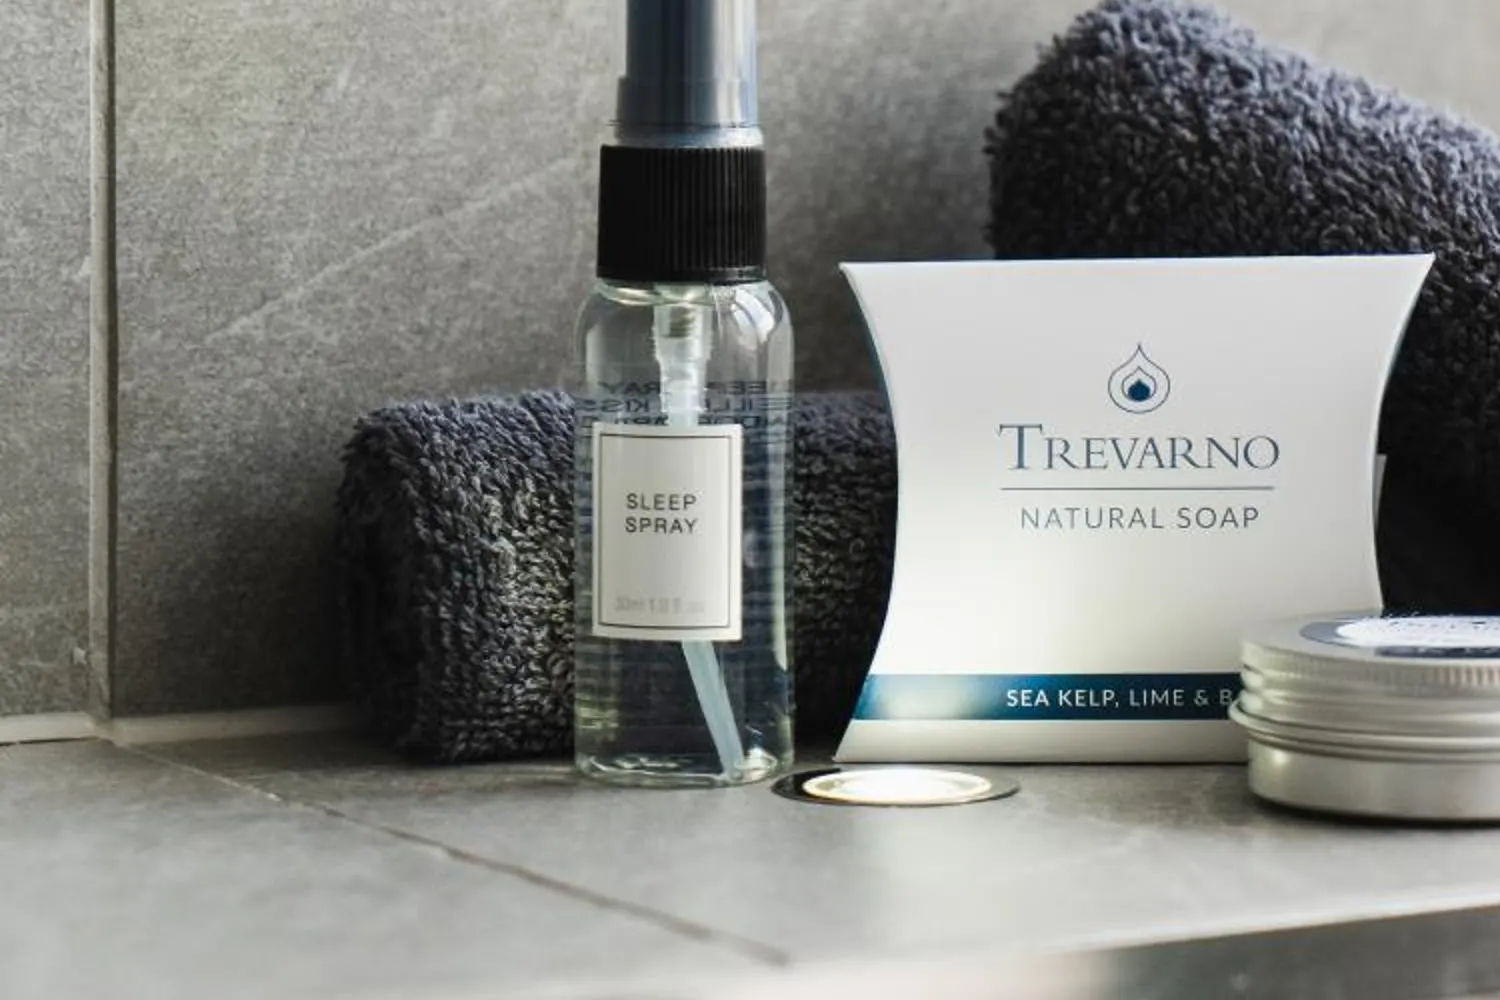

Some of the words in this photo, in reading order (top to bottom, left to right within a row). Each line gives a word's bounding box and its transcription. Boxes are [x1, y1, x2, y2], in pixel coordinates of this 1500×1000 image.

[999, 423, 1280, 469] TREVARNO
[626, 492, 698, 511] SLEEP
[625, 516, 698, 534] SPRAY
[1021, 507, 1164, 529] NATURAL
[1177, 507, 1259, 529] SOAP
[1006, 689, 1050, 707] SEA
[1058, 689, 1119, 709] KELP,
[1129, 689, 1185, 707] LIME
[1194, 689, 1212, 707] &
